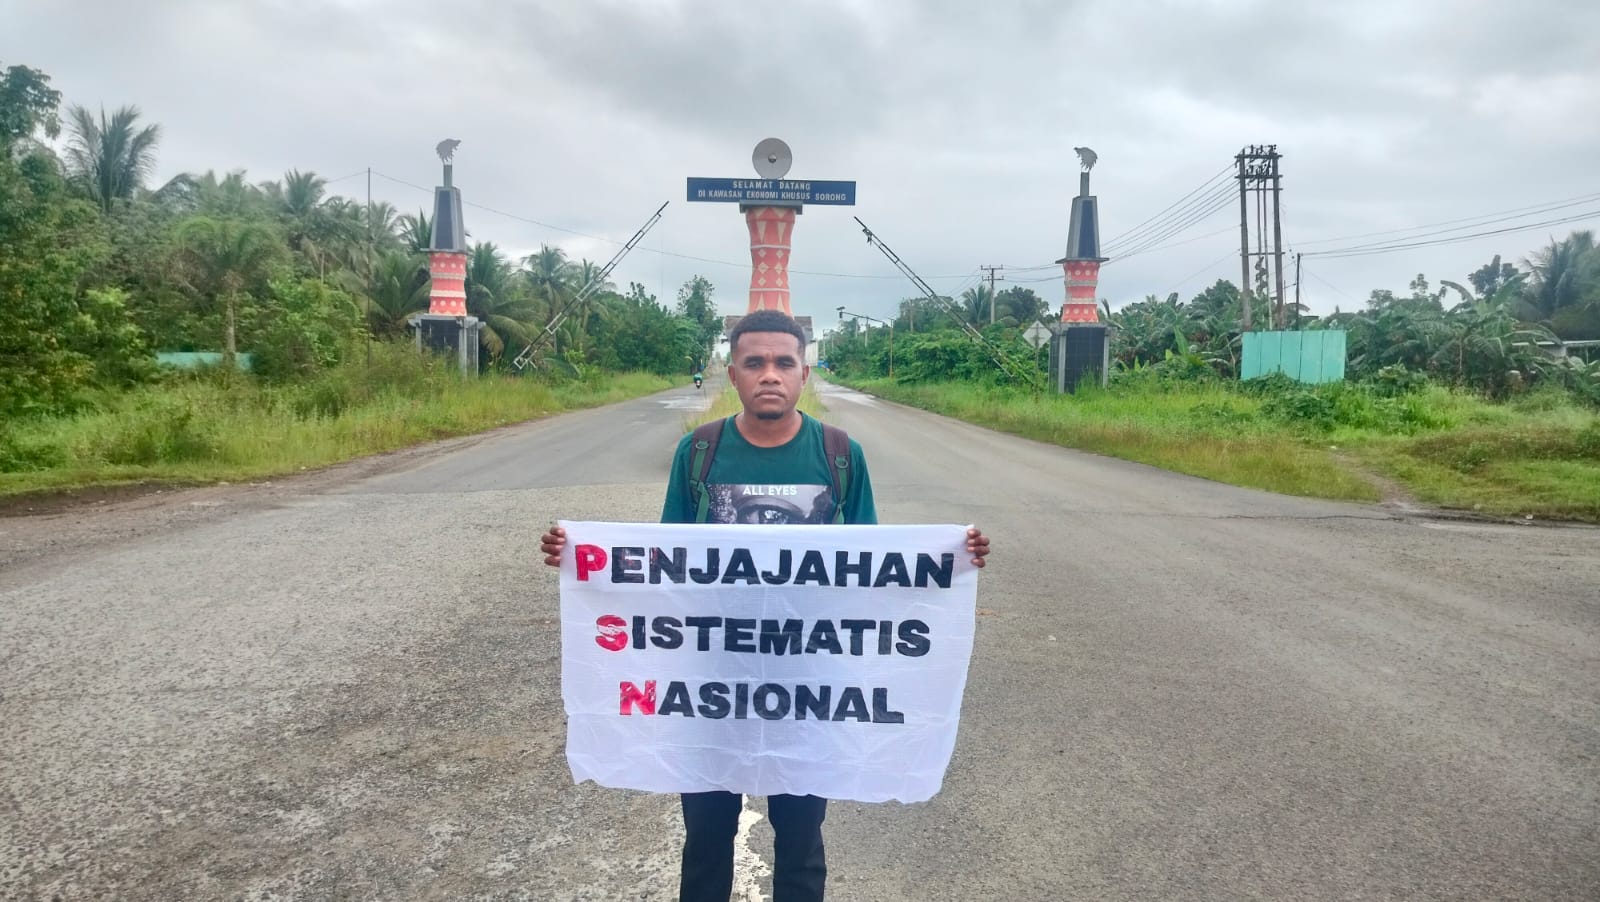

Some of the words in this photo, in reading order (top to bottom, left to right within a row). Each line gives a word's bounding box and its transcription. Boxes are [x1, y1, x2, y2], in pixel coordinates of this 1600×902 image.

[698, 190, 706, 198] DI
[708, 190, 743, 198] KAWASAN
[746, 191, 779, 200] EKONOMI
[781, 191, 811, 200] KHUSUS
[815, 193, 847, 201] SORONG
[733, 181, 773, 189] SELAMAT
[779, 182, 811, 190] DATANG
[742, 485, 765, 496] ALL
[768, 485, 798, 496] EYES
[575, 544, 955, 588] PENJAJAHAN
[595, 614, 931, 657] SISTEMATIS
[619, 680, 905, 724] NASIONAL
